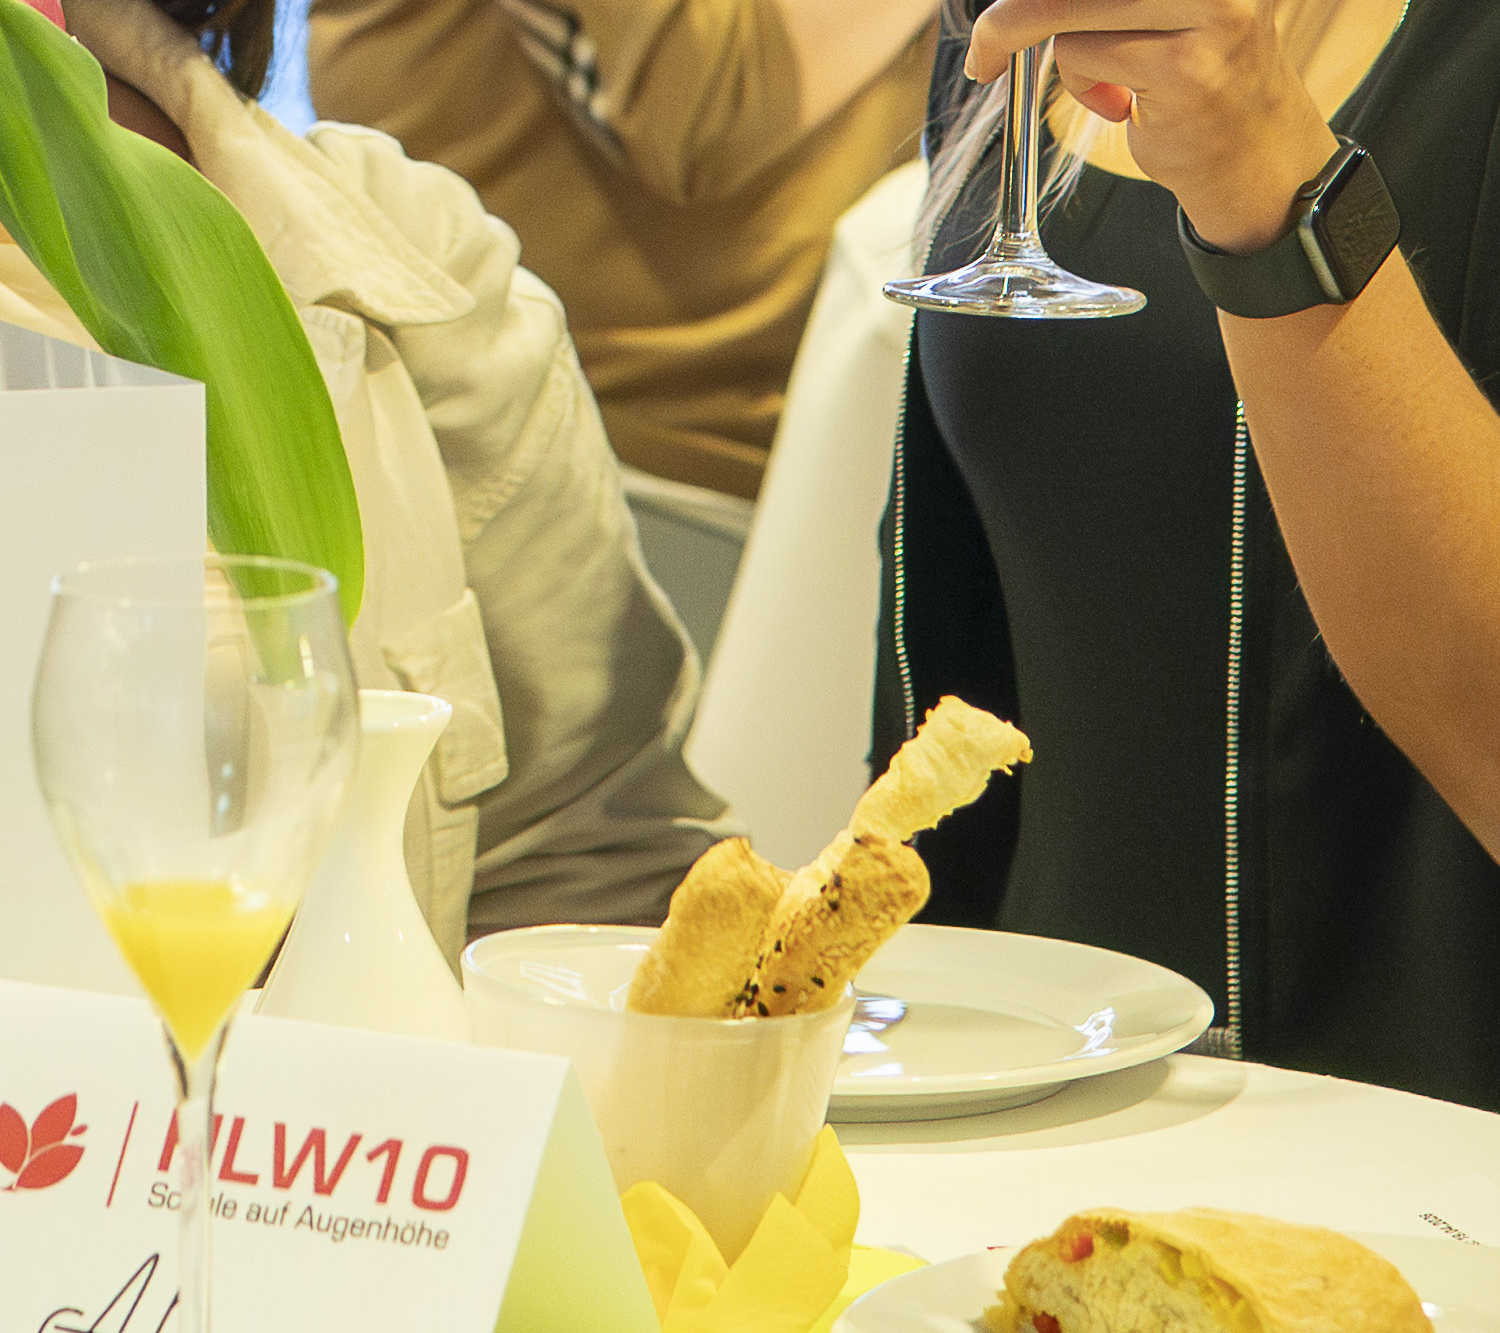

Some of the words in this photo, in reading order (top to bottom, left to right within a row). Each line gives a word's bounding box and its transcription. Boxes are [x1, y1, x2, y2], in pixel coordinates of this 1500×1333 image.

[147, 1181, 238, 1220] Scle
[245, 1200, 292, 1227] auf
[294, 1204, 450, 1251] Augenhöhe
